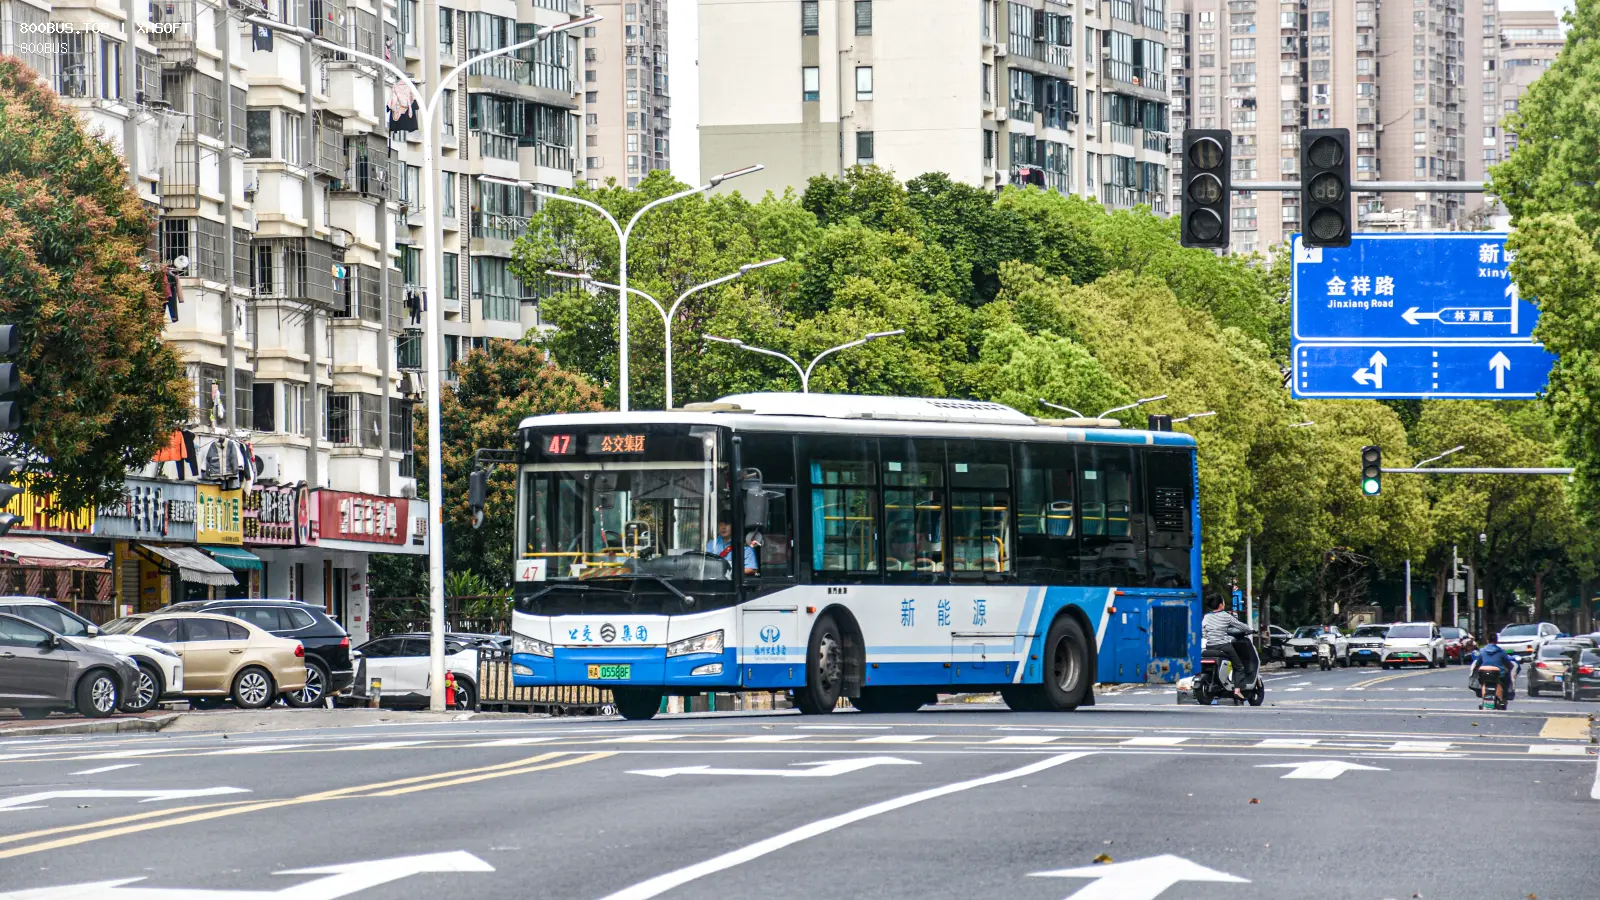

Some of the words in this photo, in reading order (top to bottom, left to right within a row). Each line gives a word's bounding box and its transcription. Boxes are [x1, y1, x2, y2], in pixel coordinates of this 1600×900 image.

[1326, 275, 1395, 296] 金祥路
[1327, 299, 1369, 310] Jinxiang
[1371, 299, 1394, 309] Road
[1454, 310, 1494, 322] 林洲路
[548, 434, 571, 454] 47
[601, 434, 645, 452] 公交集团
[522, 566, 539, 582] 47
[900, 598, 987, 627] 新能源
